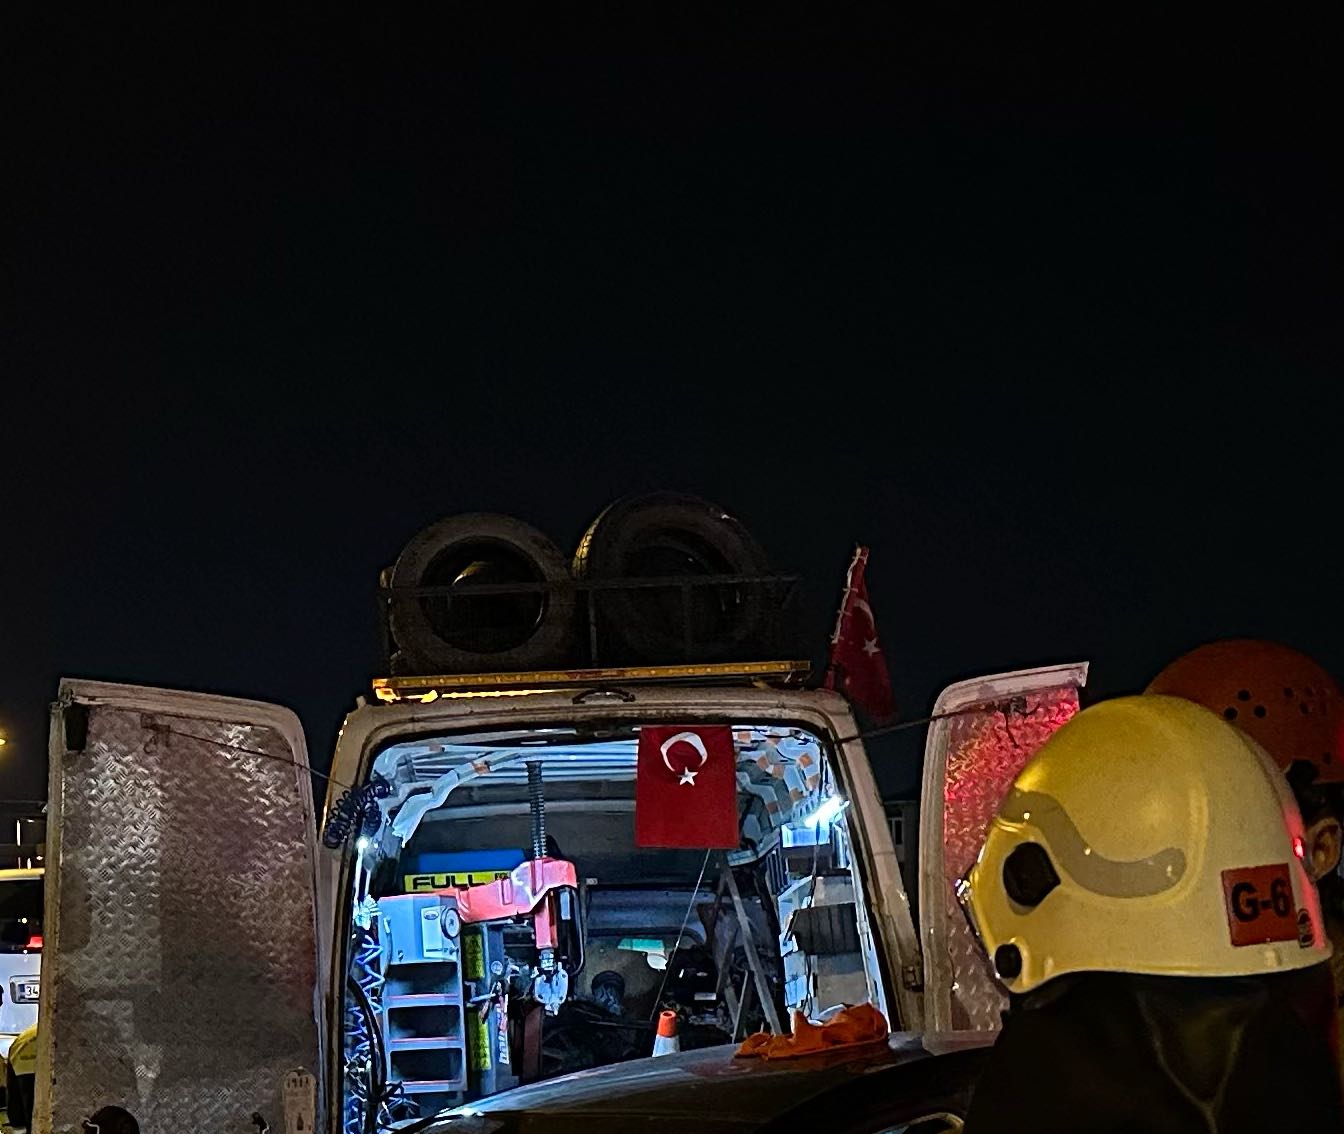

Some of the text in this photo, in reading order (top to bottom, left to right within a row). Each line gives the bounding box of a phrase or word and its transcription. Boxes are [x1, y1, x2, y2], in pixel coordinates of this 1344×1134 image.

[413, 874, 486, 890] FULL
[1231, 878, 1291, 922] G-6
[26, 985, 39, 997] 34
